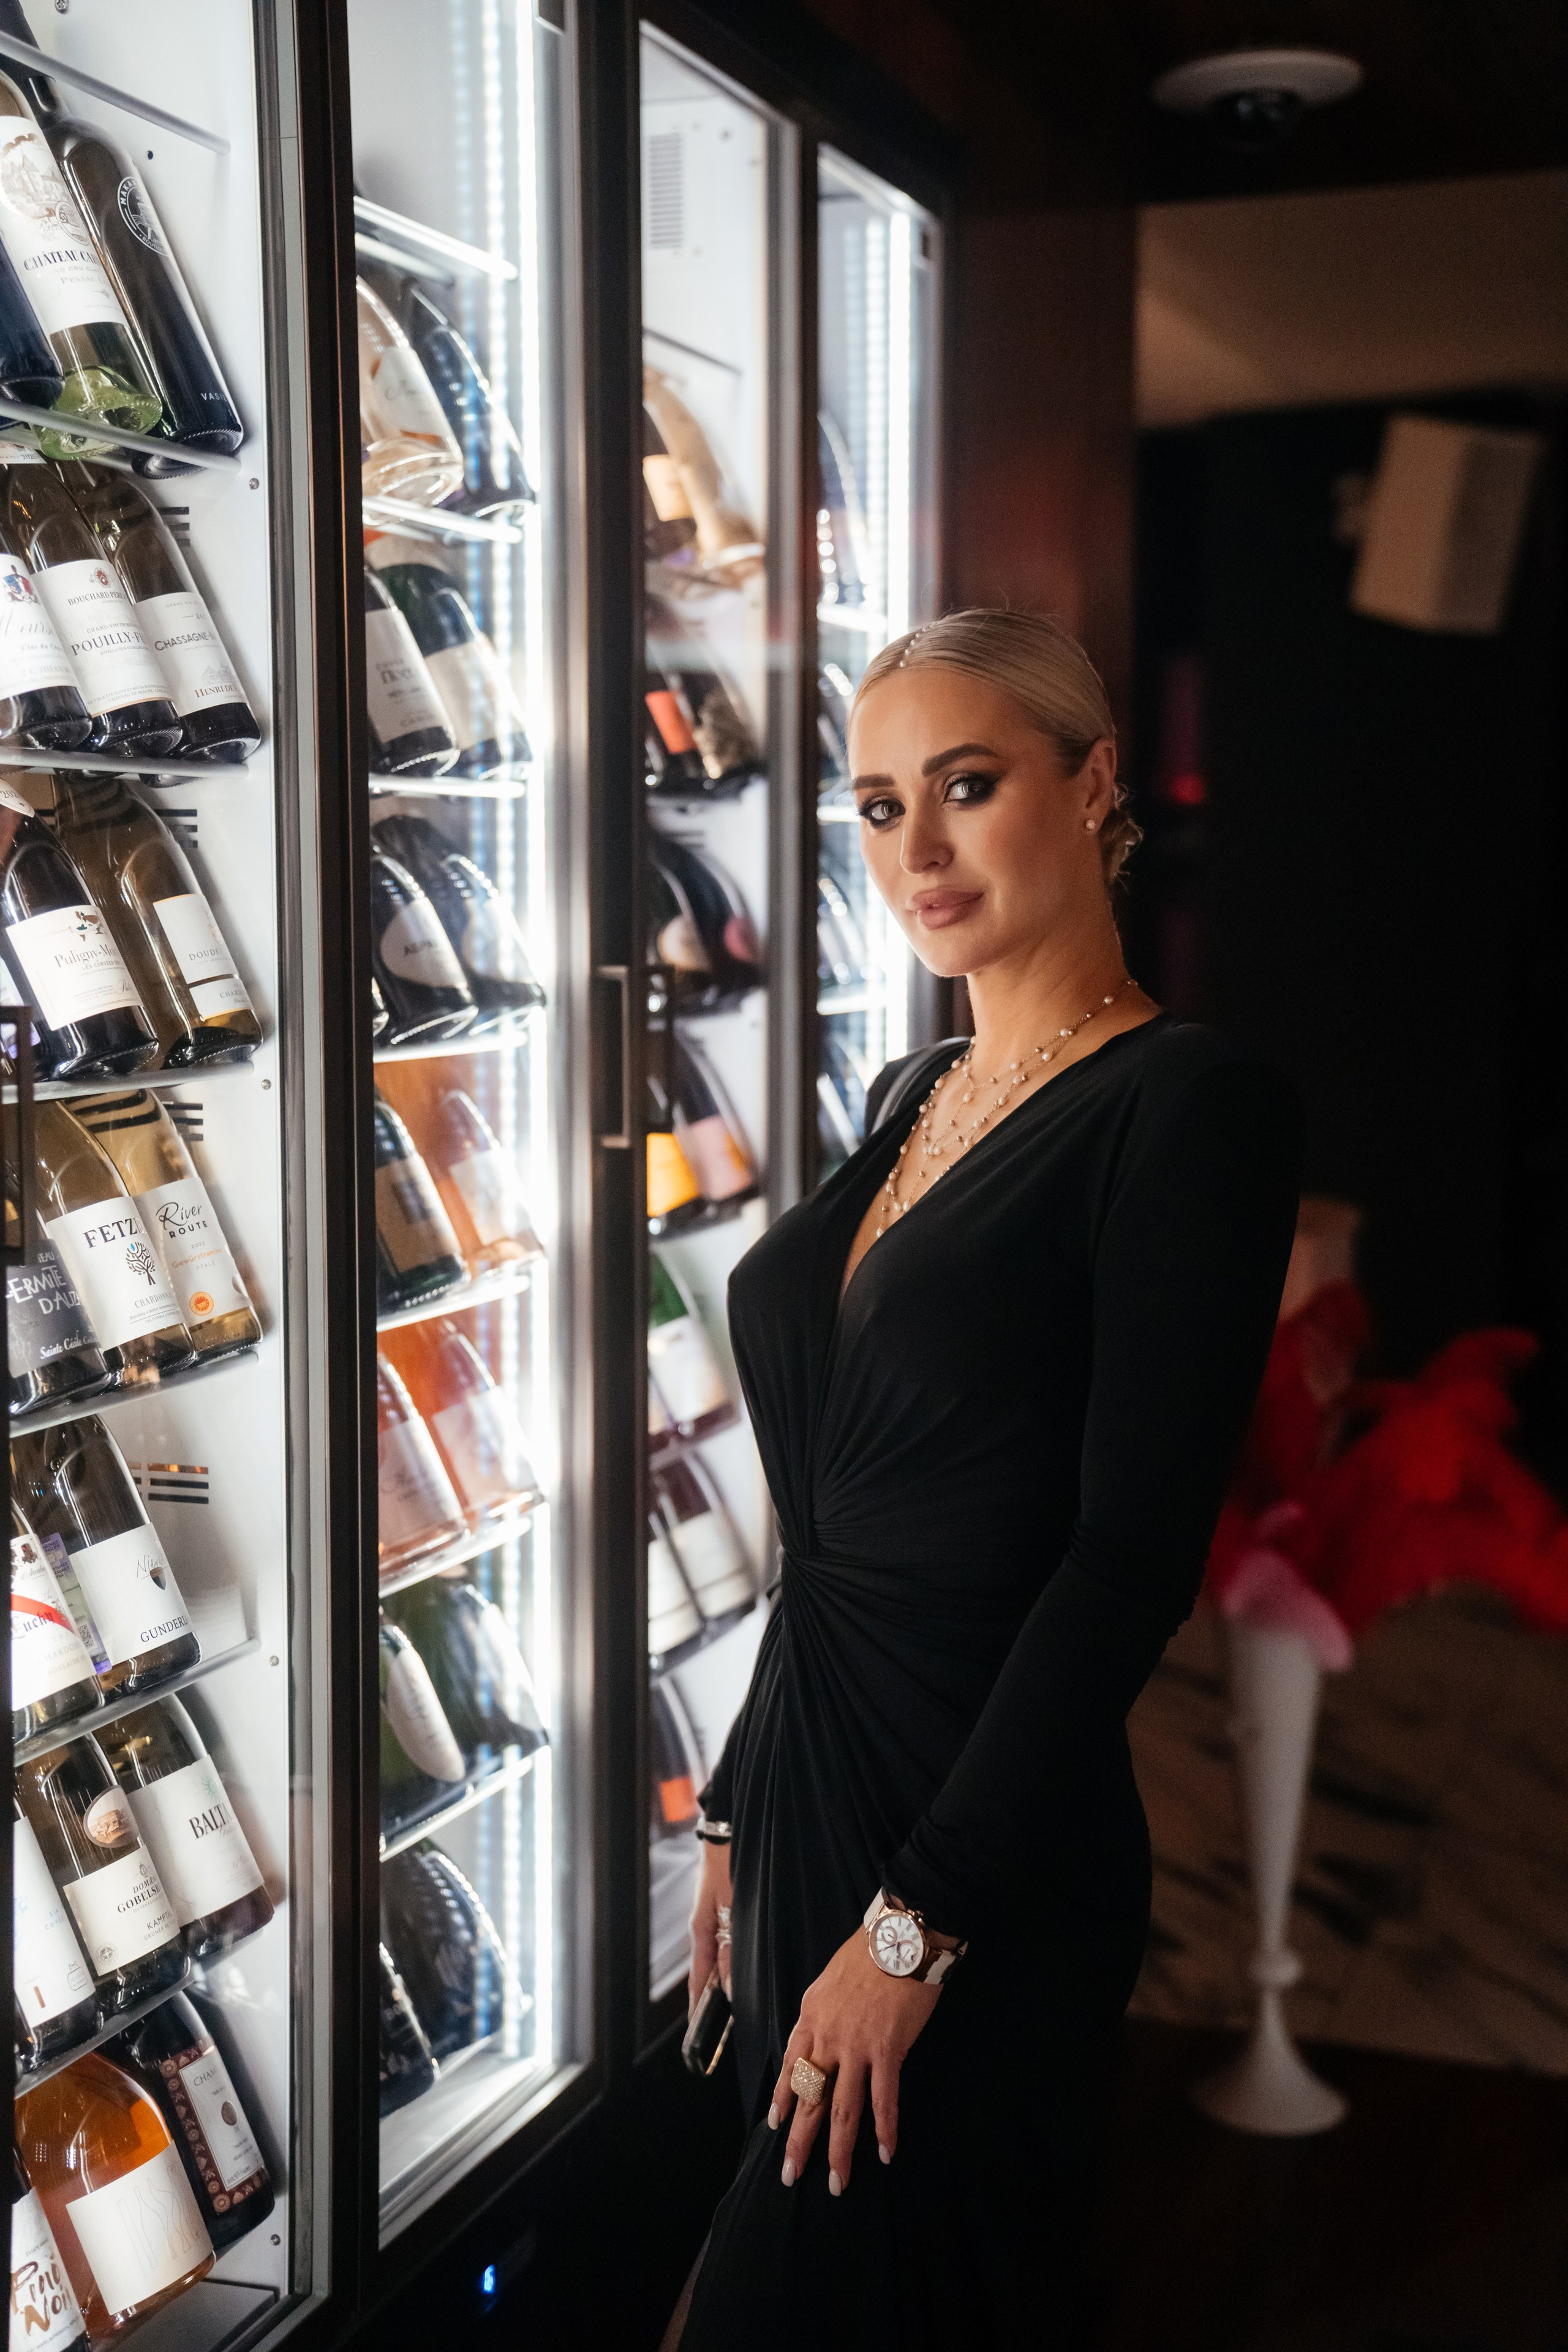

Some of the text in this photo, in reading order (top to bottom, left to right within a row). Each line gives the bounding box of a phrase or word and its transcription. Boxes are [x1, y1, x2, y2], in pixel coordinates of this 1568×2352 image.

[23, 250, 80, 271] CHÂTEAU
[67, 592, 110, 606] BOUCHARD
[86, 625, 108, 633] GRAND
[70, 631, 147, 656] POUILLY-FU
[194, 687, 223, 698] HENRI
[0, 790, 22, 799] 202
[156, 1202, 202, 1230] River
[169, 1221, 208, 1238] ROUTE
[134, 1292, 171, 1308] CHARDONN
[129, 1310, 146, 1321] Building
[40, 1343, 63, 1359] Sainte
[64, 1330, 82, 1350] Cécile
[144, 1927, 164, 1941] GRÜNER
